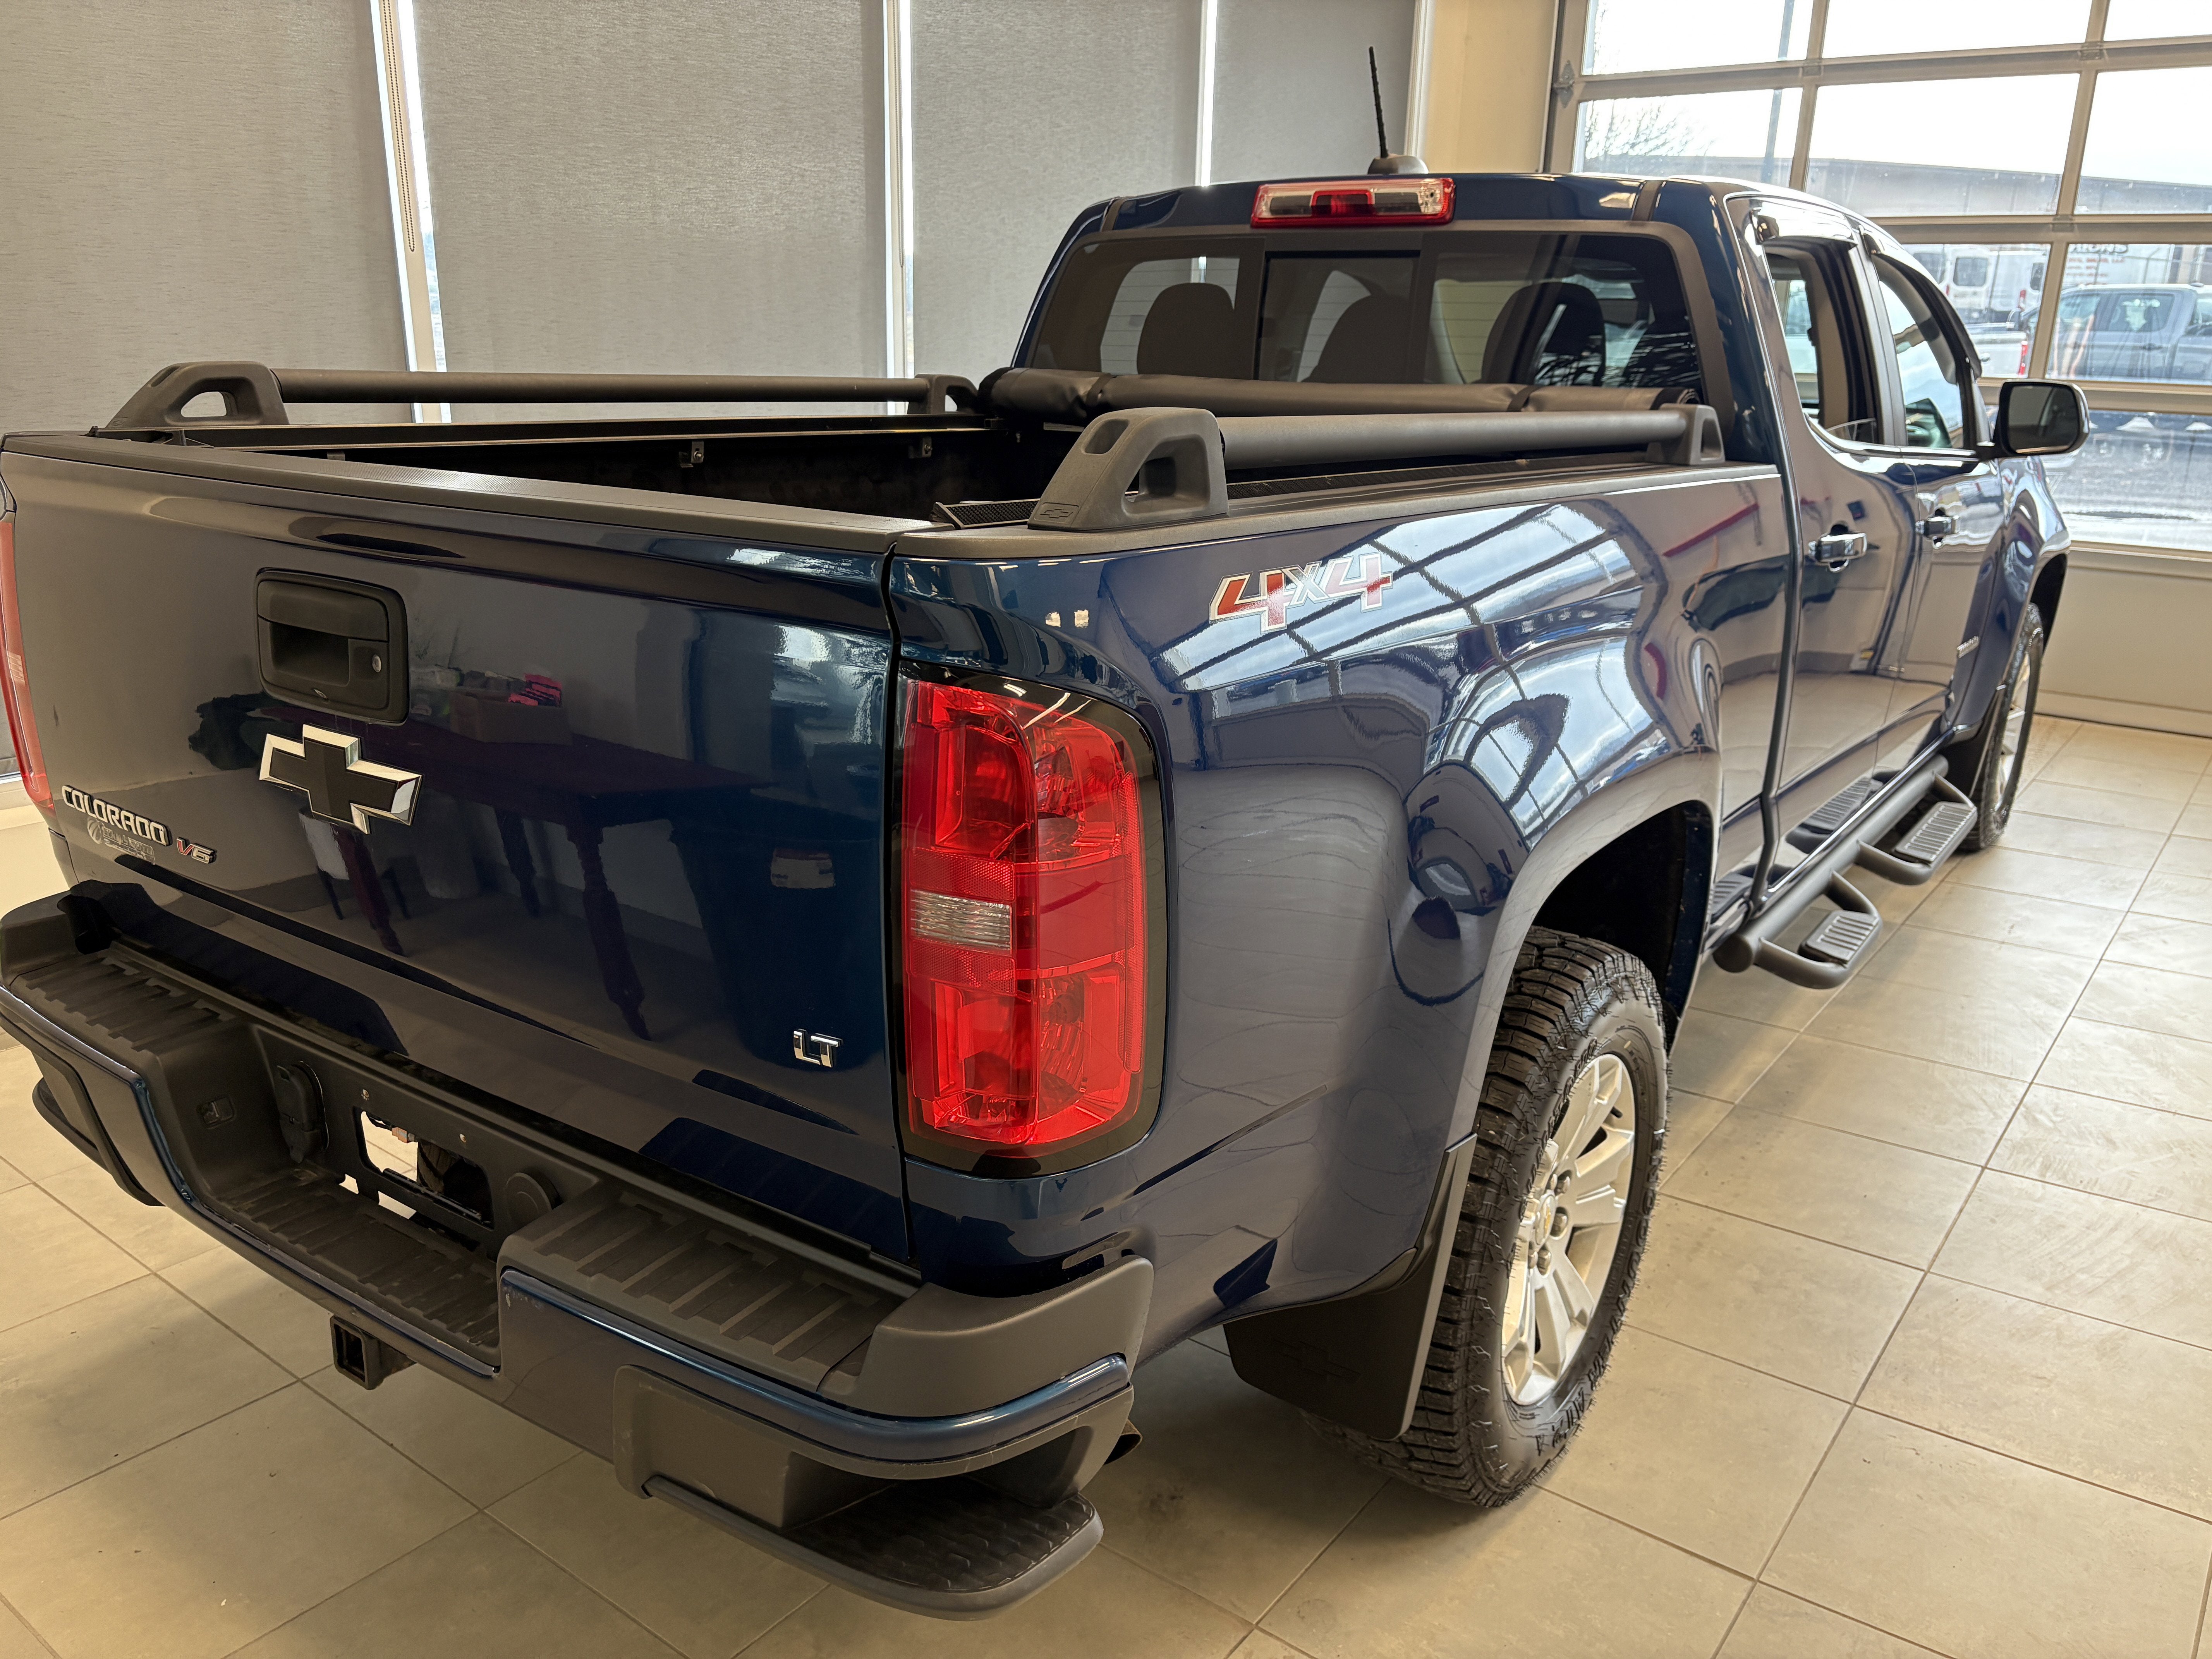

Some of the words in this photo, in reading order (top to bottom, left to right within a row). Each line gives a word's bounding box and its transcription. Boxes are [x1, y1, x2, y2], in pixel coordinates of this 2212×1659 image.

[62, 785, 169, 847] COLORADO
[177, 837, 215, 864] V6
[793, 1029, 841, 1068] LT
